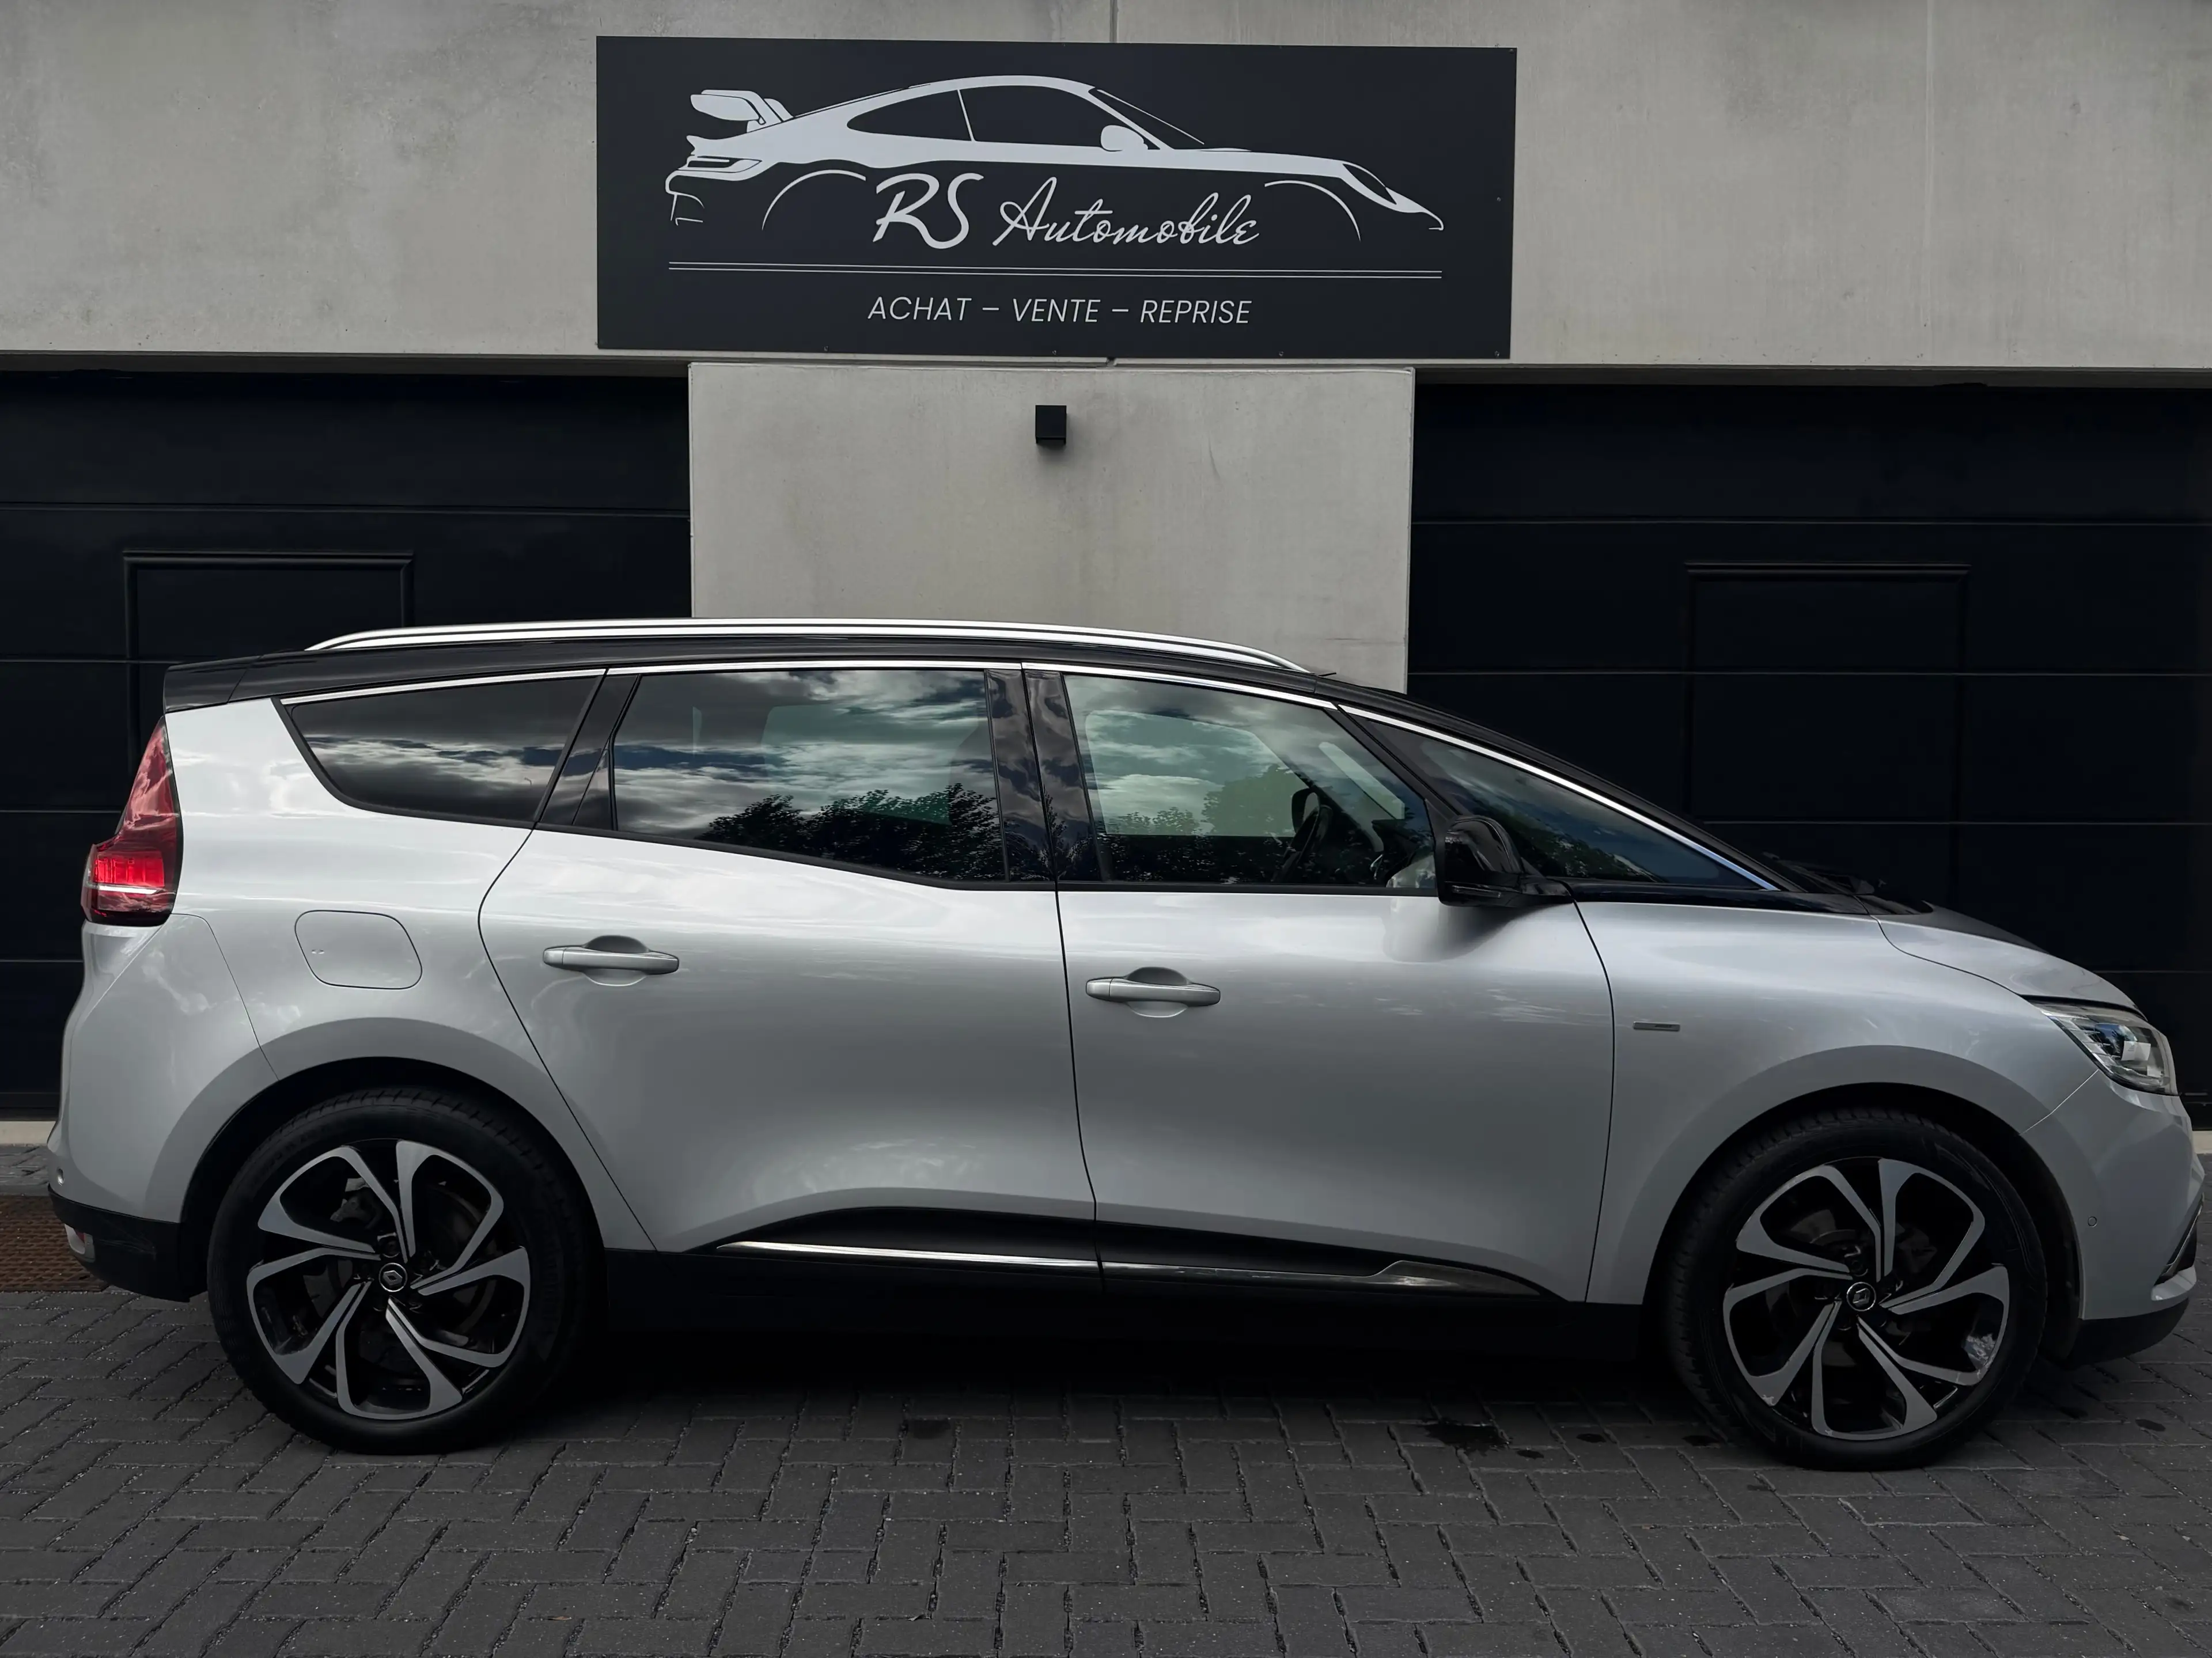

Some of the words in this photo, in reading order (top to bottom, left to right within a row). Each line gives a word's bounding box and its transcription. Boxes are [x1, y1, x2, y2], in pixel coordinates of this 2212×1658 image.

[872, 172, 984, 249] RS
[992, 176, 1260, 246] Automobile
[868, 297, 972, 321] ACHAT
[1013, 298, 1101, 323] VENTE
[1140, 300, 1253, 324] REPRISE
